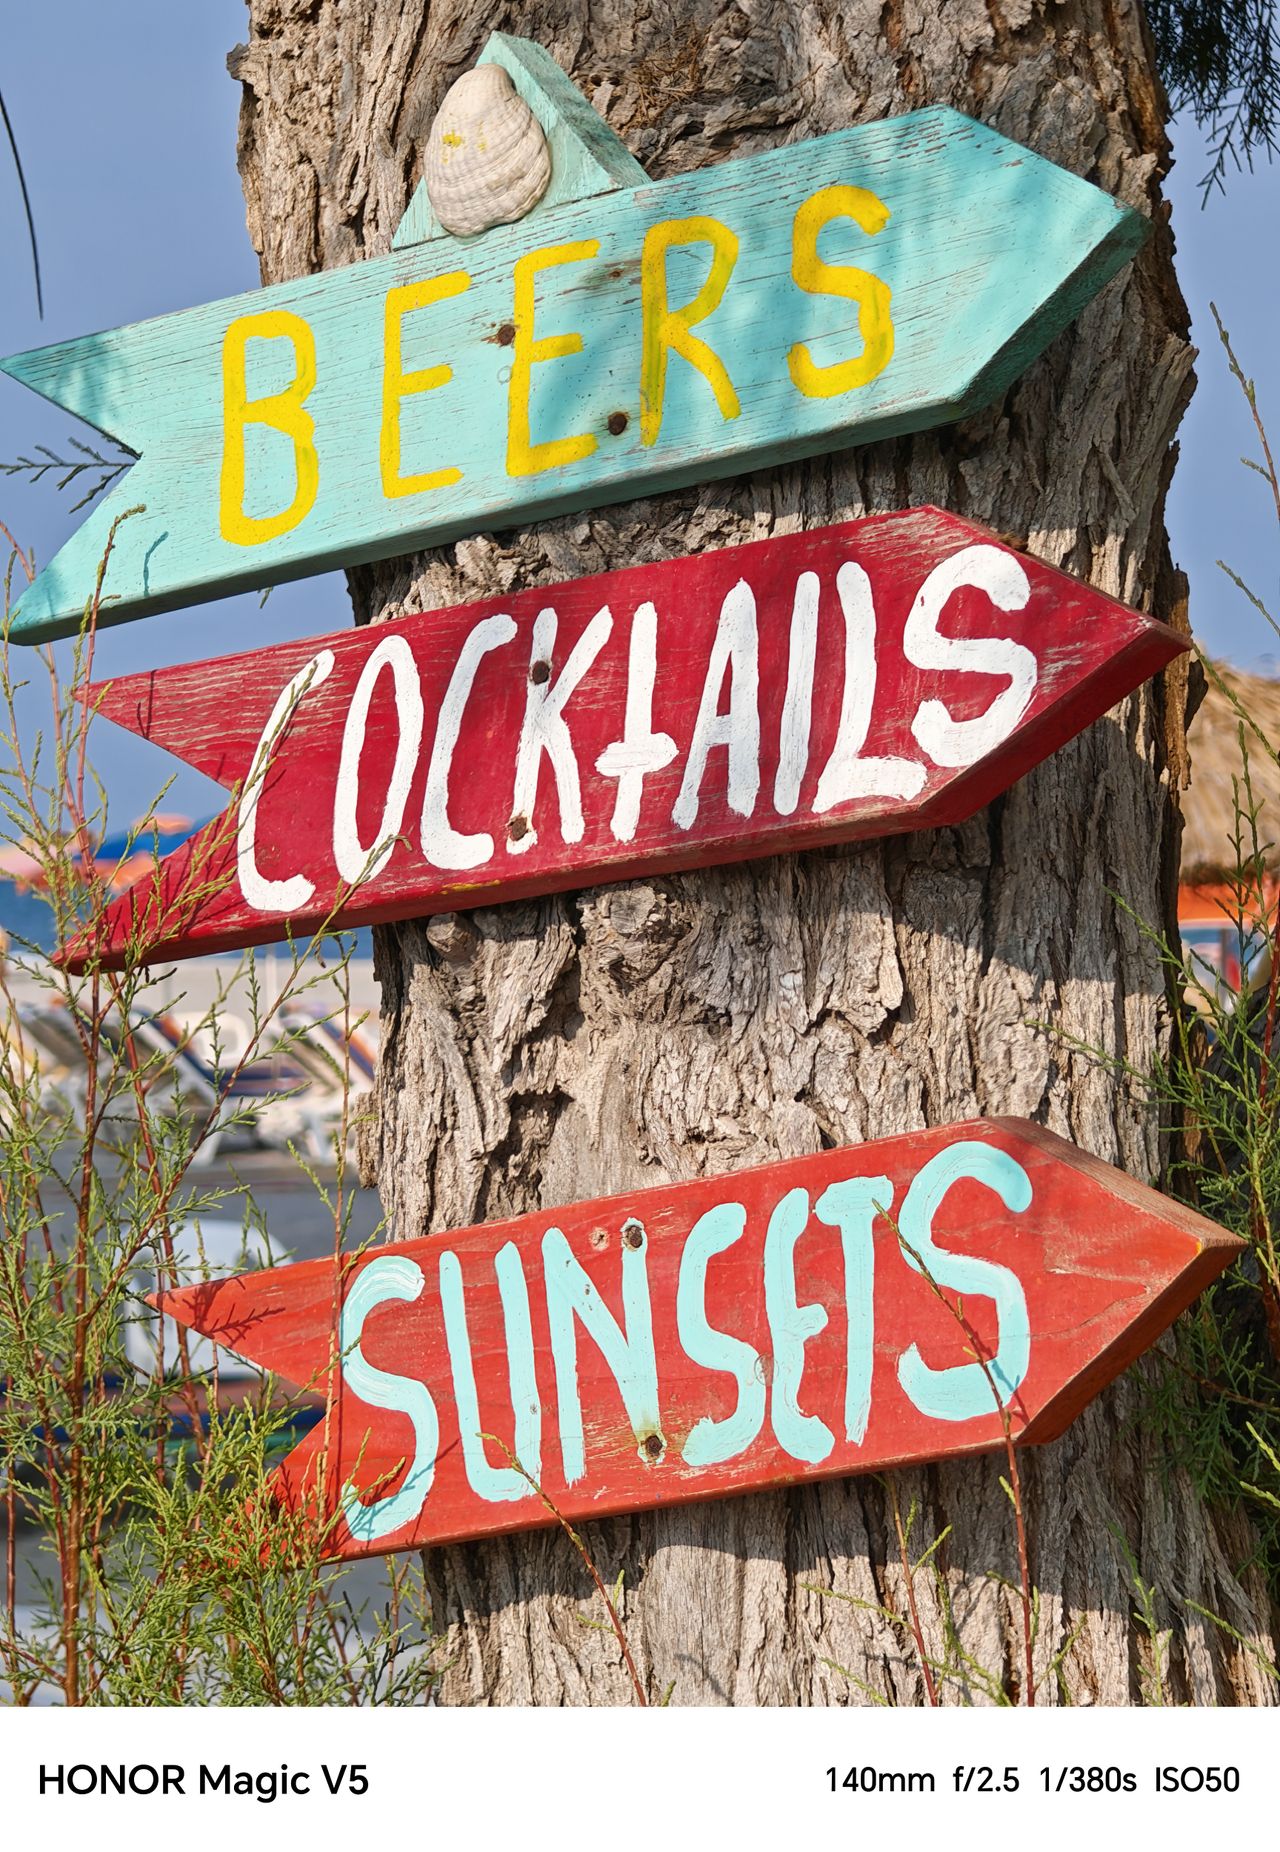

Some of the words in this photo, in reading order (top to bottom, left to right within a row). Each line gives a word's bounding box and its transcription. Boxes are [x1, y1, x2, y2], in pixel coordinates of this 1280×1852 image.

[220, 185, 895, 547] BEERS
[237, 544, 1038, 914] COCKTAILS
[340, 1142, 1033, 1541] SUNSETS
